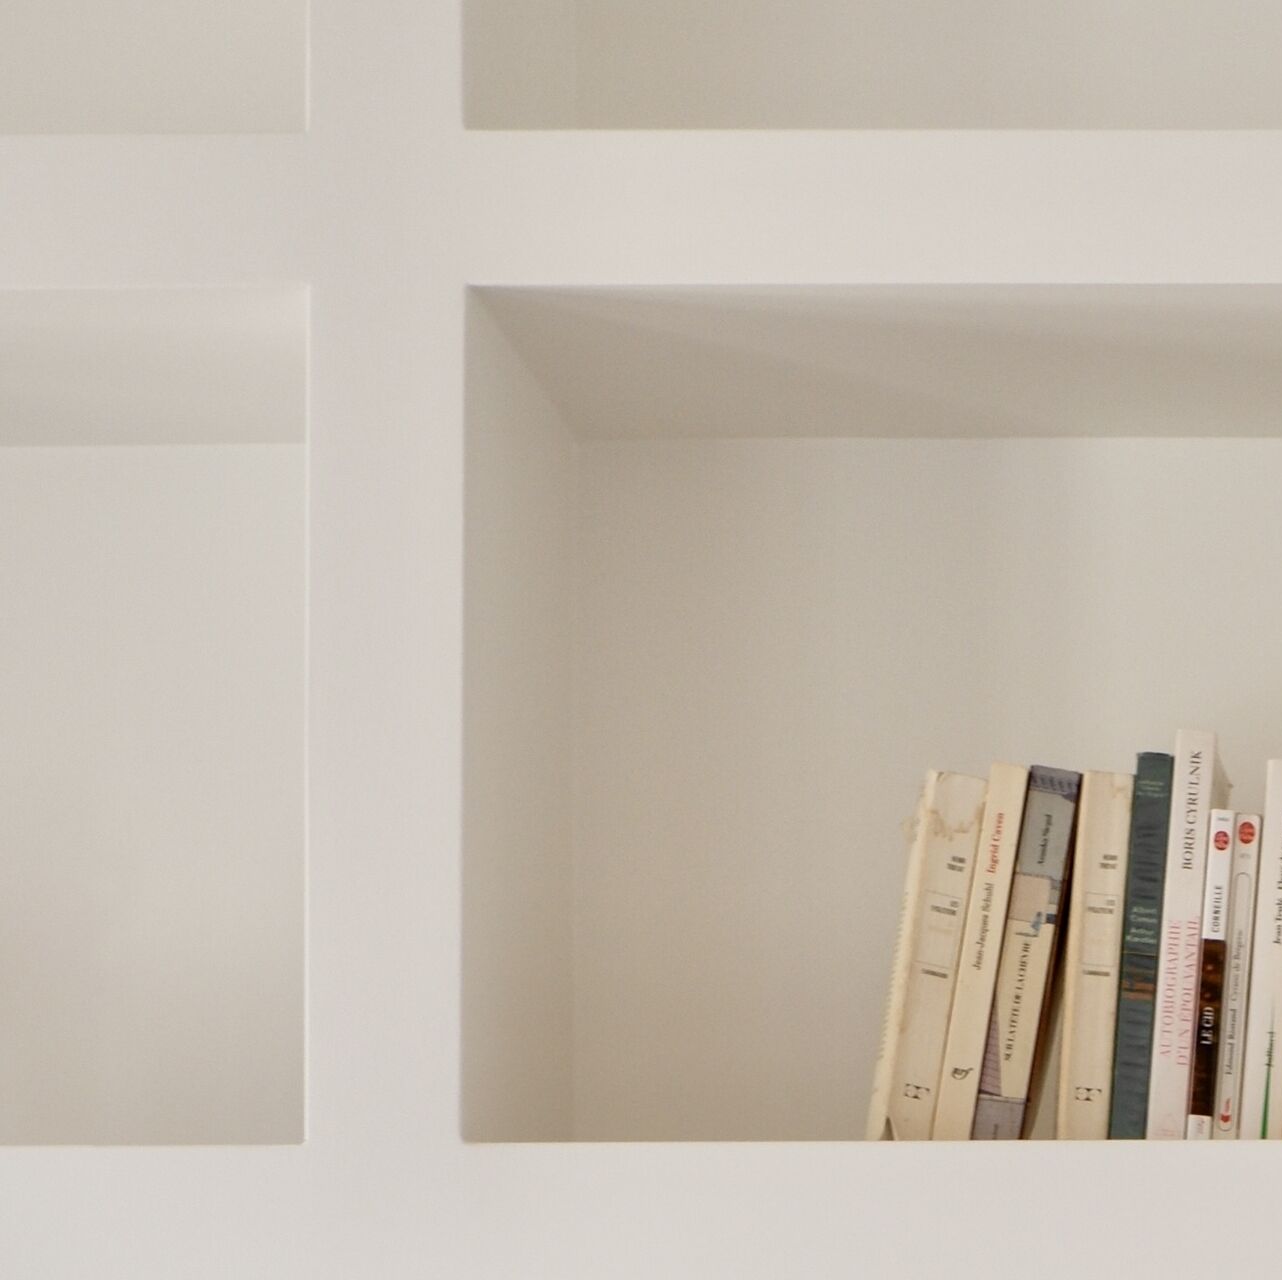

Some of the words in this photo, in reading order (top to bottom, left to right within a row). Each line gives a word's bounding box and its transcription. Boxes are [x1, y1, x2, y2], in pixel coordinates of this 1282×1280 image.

[1185, 751, 1203, 825] CYRULNIK
[993, 812, 1006, 842] Caven
[986, 843, 1001, 874] Ingrid
[1181, 828, 1196, 870] BORIS
[972, 914, 990, 970] Jean-Jacques
[981, 882, 994, 913] Schuhl
[1211, 886, 1223, 933] CORNEILLE
[1272, 924, 1282, 945] Jean
[1160, 920, 1181, 1056] AUTOBIOGRAPHIE
[1202, 1006, 1216, 1028] CID
[1200, 1029, 1214, 1045] LE
